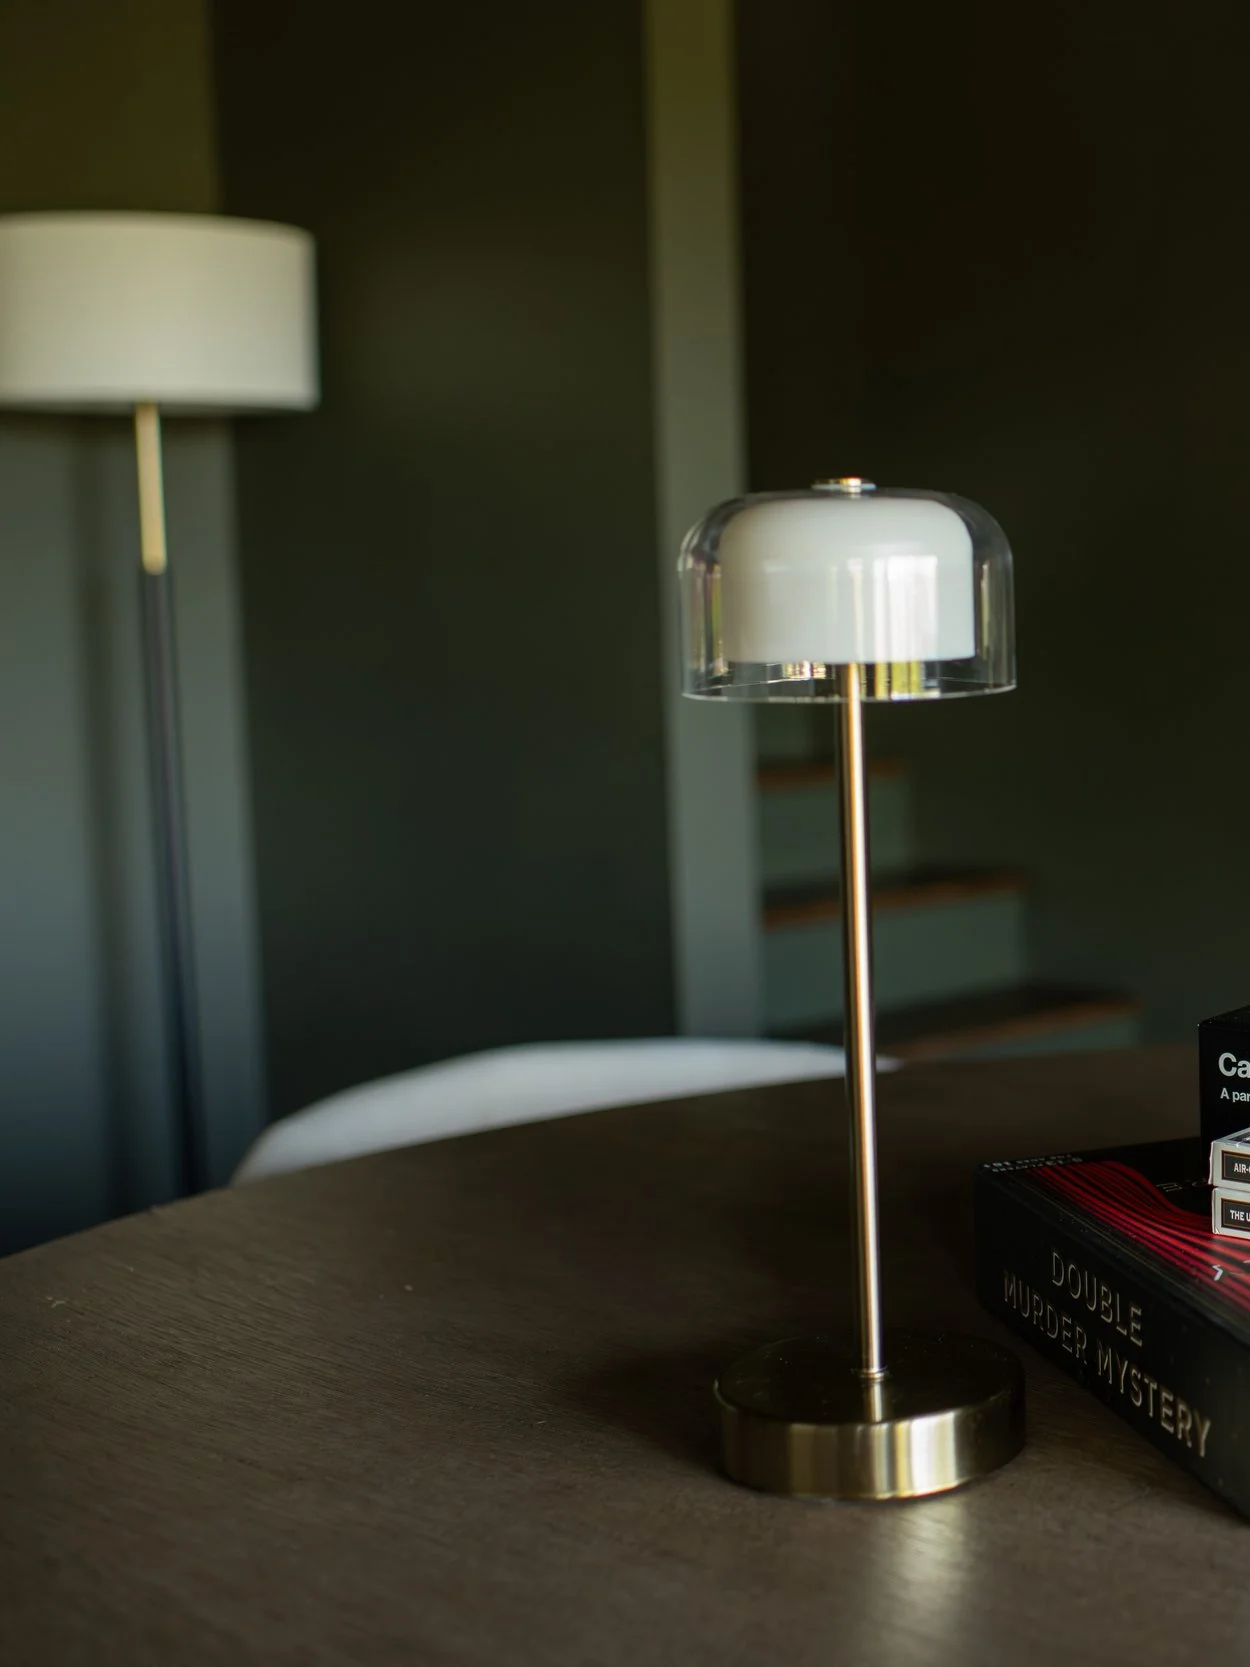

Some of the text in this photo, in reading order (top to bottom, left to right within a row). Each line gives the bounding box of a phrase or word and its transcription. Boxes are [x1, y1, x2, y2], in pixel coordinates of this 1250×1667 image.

[1220, 1087, 1230, 1100] A
[1230, 1209, 1245, 1221] THE
[1052, 1250, 1143, 1348] DOUBLE
[1004, 1270, 1211, 1458] MURDER MYSTERY
